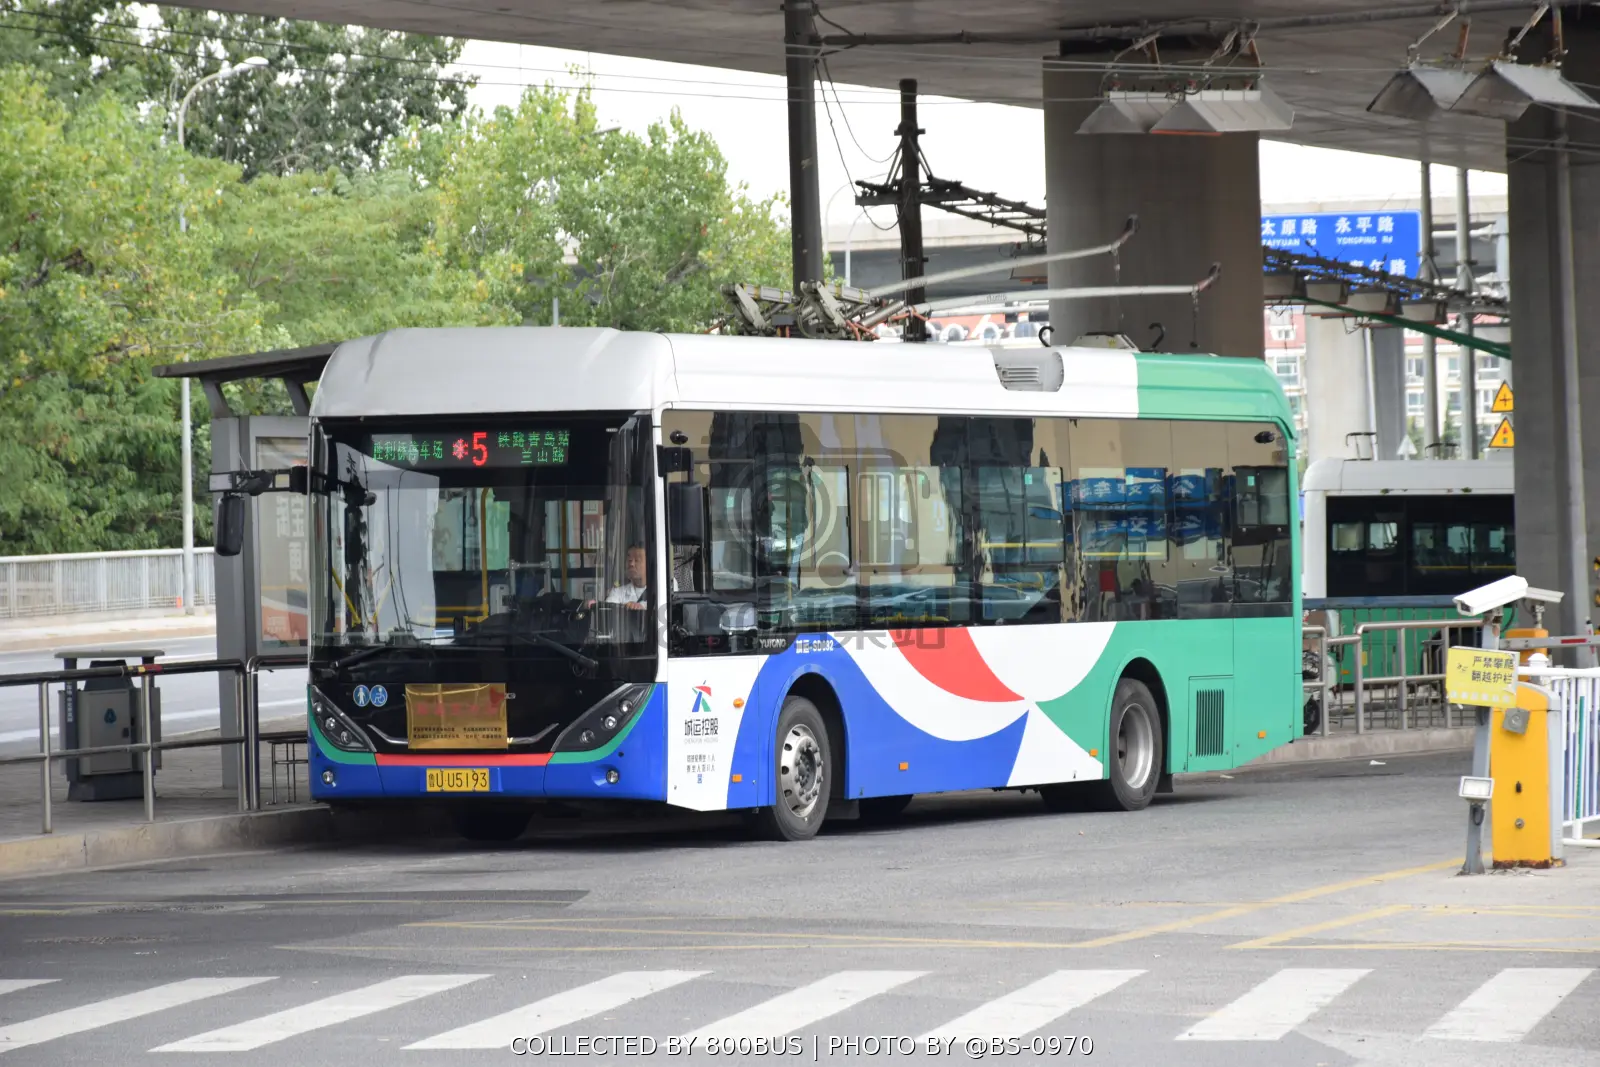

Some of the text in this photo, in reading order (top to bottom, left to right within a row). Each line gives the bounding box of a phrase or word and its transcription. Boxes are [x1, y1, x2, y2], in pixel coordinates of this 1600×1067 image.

[1261, 215, 1395, 236] 太原路 永平路
[498, 431, 570, 447] 铁路青岛站
[472, 431, 488, 466] 5
[521, 447, 565, 463] 兰山路
[1472, 655, 1514, 670] 严禁攀爬
[1471, 670, 1513, 684] 翻越护栏
[684, 717, 719, 736] 城运控股
